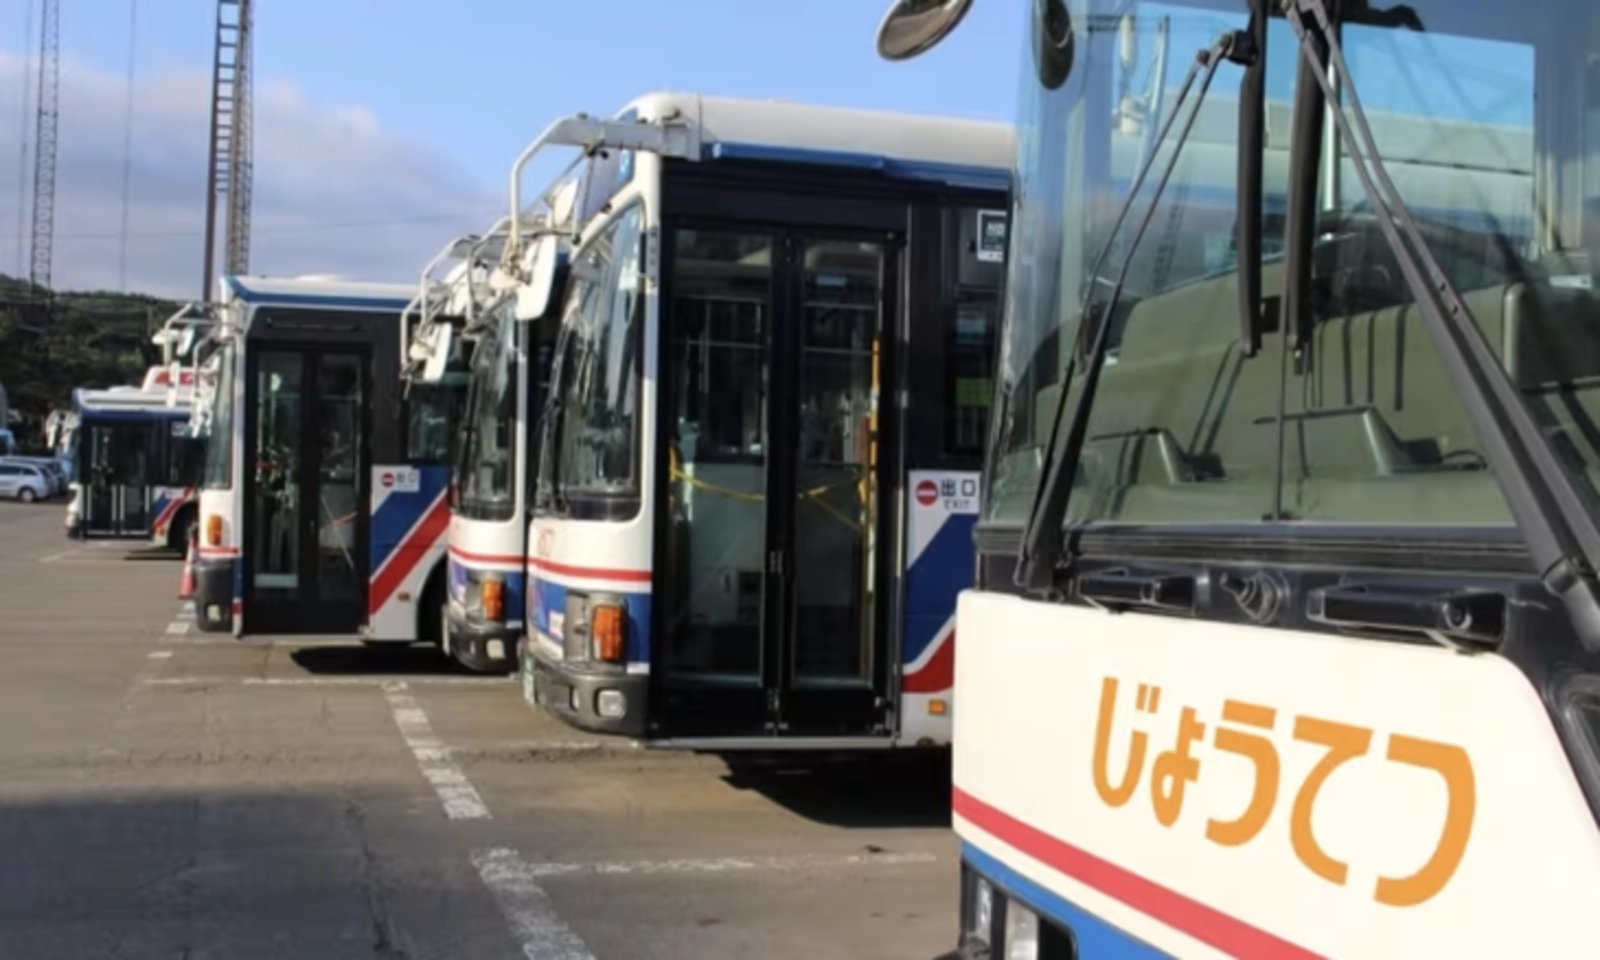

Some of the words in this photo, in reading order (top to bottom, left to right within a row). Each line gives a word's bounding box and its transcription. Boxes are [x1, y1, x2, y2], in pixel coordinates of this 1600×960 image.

[941, 478, 976, 497] 出口
[1092, 676, 1475, 907] じょうてつ
